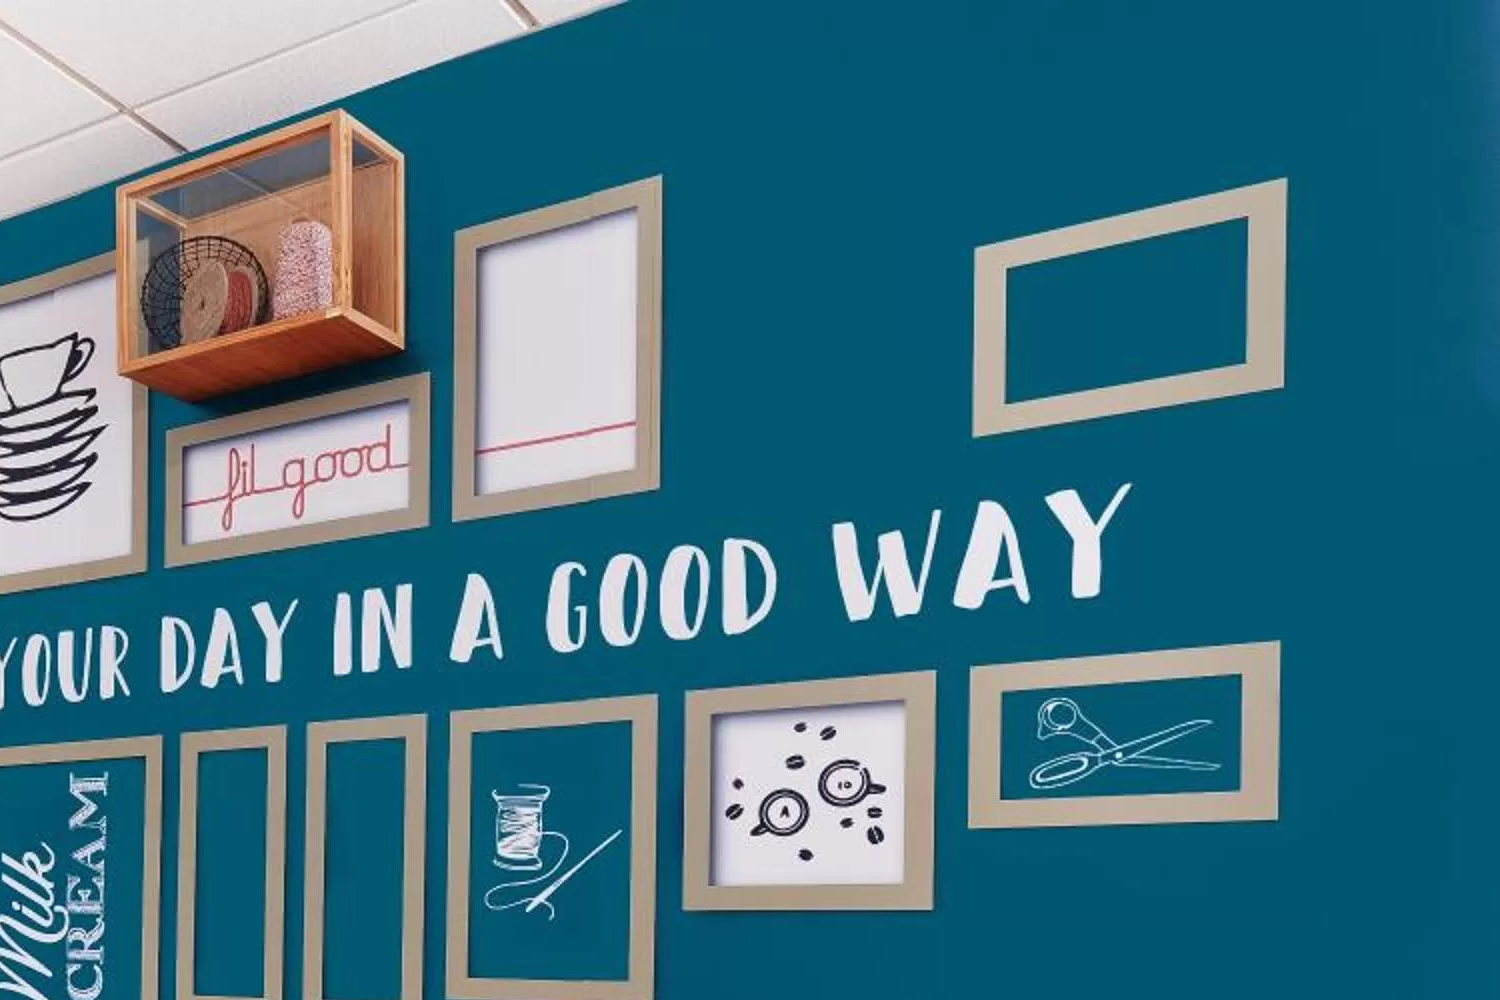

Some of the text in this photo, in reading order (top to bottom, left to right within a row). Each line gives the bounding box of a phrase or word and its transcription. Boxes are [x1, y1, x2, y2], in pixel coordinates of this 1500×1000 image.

[221, 423, 393, 532] fil good
[160, 598, 299, 693] DAY
[333, 583, 413, 676] IN
[450, 573, 503, 663] A
[546, 537, 778, 654] GOOD
[832, 482, 1132, 622] WAY
